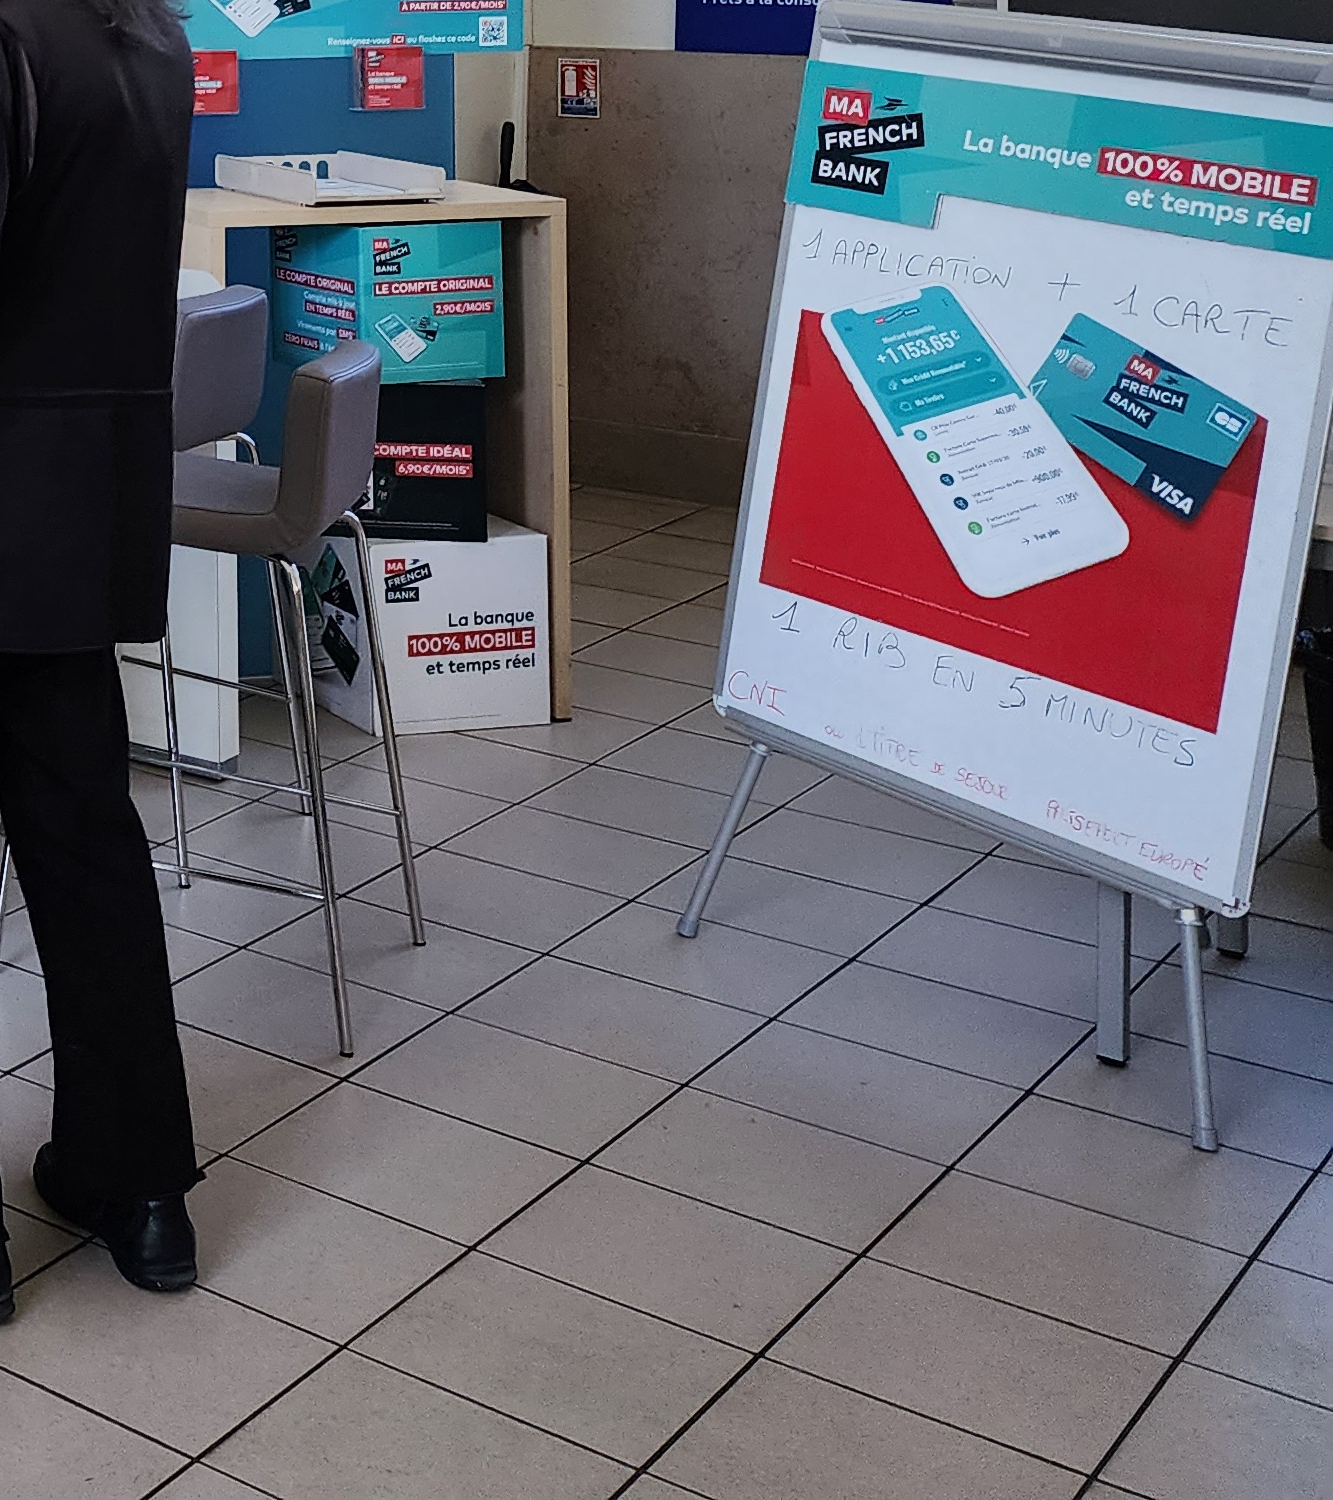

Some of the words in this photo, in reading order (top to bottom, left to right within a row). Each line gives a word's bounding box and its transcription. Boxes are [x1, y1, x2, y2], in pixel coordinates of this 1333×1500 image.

[962, 129, 996, 157] La
[998, 131, 1093, 171] banque
[1102, 150, 1184, 183] 100%
[1189, 162, 1312, 203] MOBILE
[1123, 185, 1155, 211] et
[1161, 190, 1251, 227] temps
[1255, 206, 1313, 236] réel
[375, 284, 388, 296] LE
[391, 281, 438, 294] COMPTE
[439, 278, 492, 292] ORIGINAL
[802, 228, 824, 262] 1
[831, 238, 1013, 289] APPLICATION
[1112, 283, 1138, 317] 1
[1151, 294, 1295, 349] CARTE
[1148, 473, 1195, 516] VISA
[771, 601, 801, 633] 1
[832, 615, 907, 670] RIB
[932, 654, 975, 693] EN
[998, 676, 1042, 710] 5
[1044, 692, 1198, 768] MINUTES
